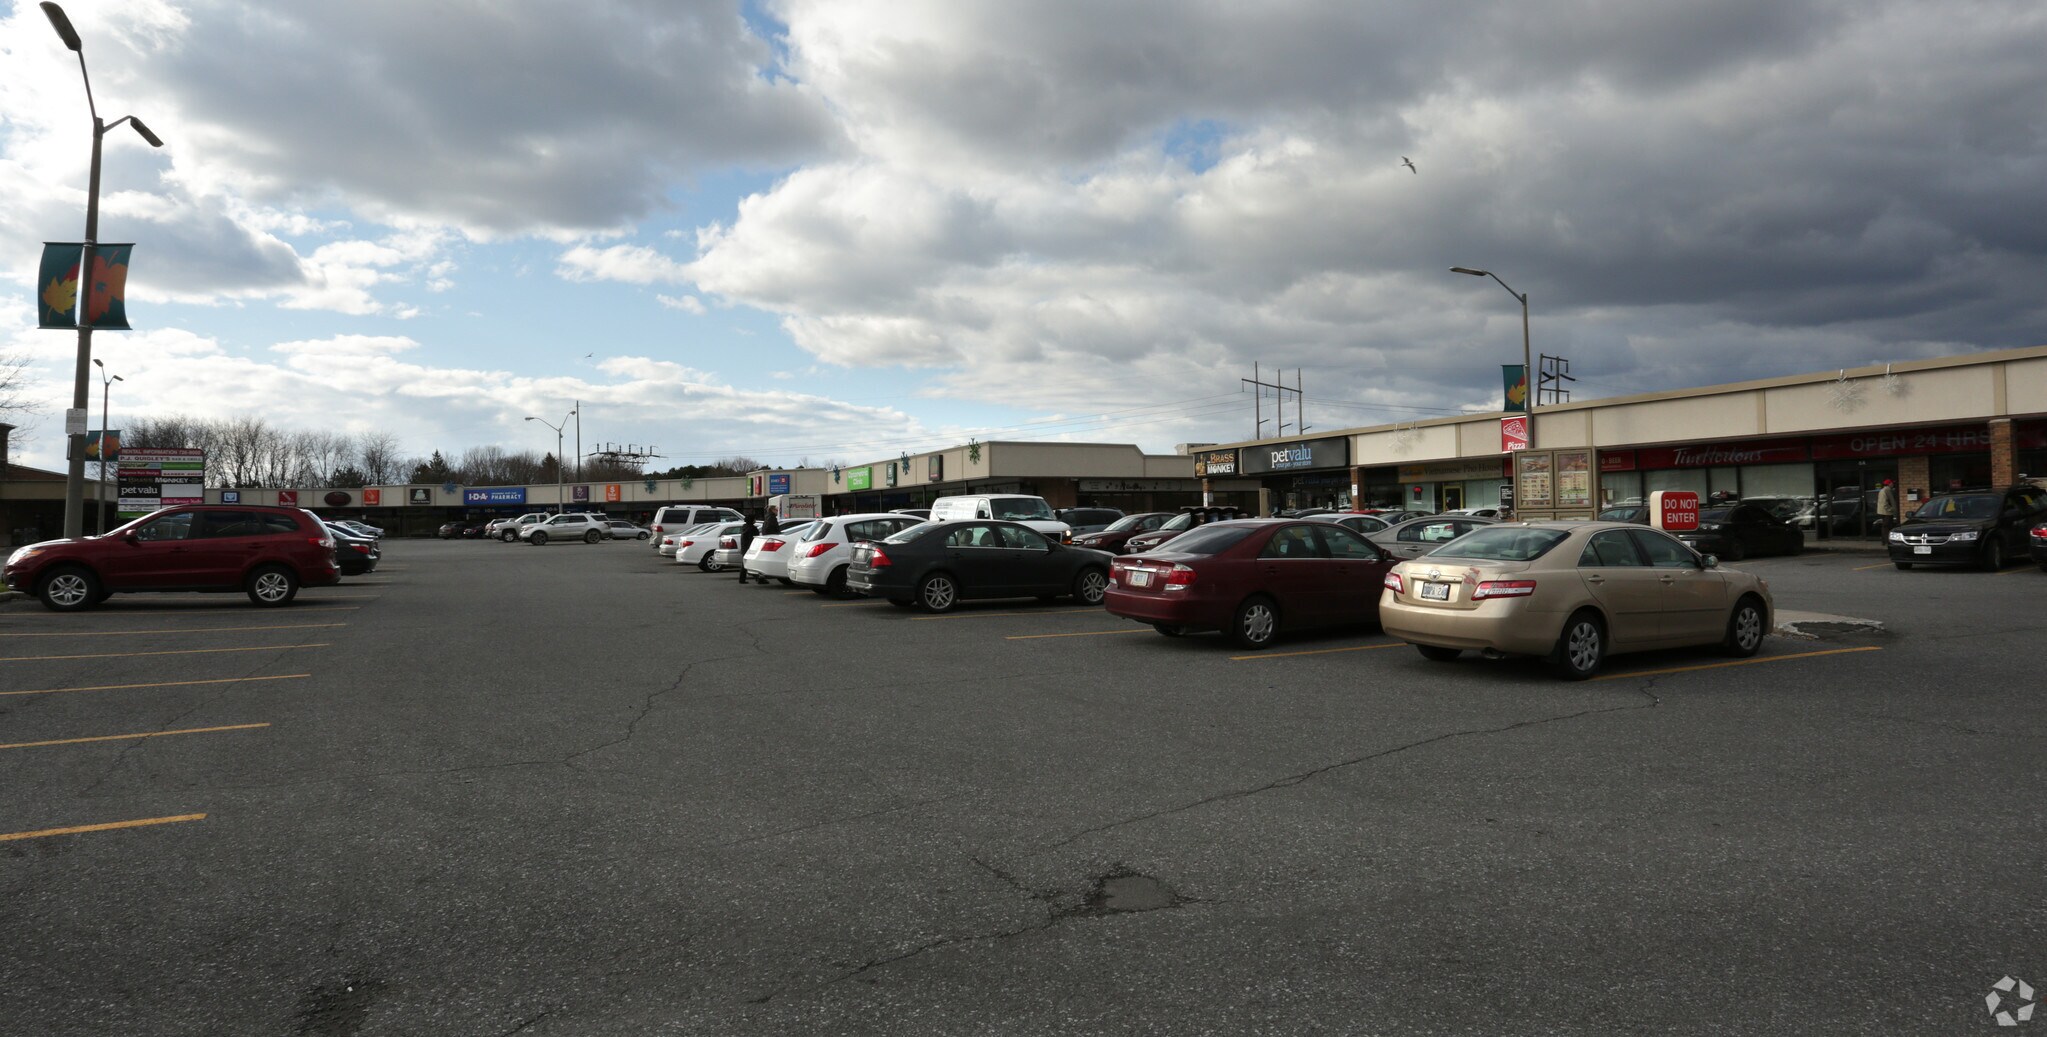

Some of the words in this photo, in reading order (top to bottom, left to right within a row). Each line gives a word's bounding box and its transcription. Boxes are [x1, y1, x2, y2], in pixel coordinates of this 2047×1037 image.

[1507, 441, 1526, 450] Pizza
[1850, 436, 1906, 452] OPEN
[1914, 434, 1937, 448] 24
[1946, 430, 1992, 447] HRS
[1210, 453, 1235, 463] BRASS
[1673, 448, 1700, 465] Tim
[1702, 446, 1762, 463] Hortons
[1206, 463, 1235, 475] MONKEY
[1664, 498, 1677, 510] DO
[1680, 498, 1698, 510] NOT
[1666, 512, 1696, 523] ENTER
